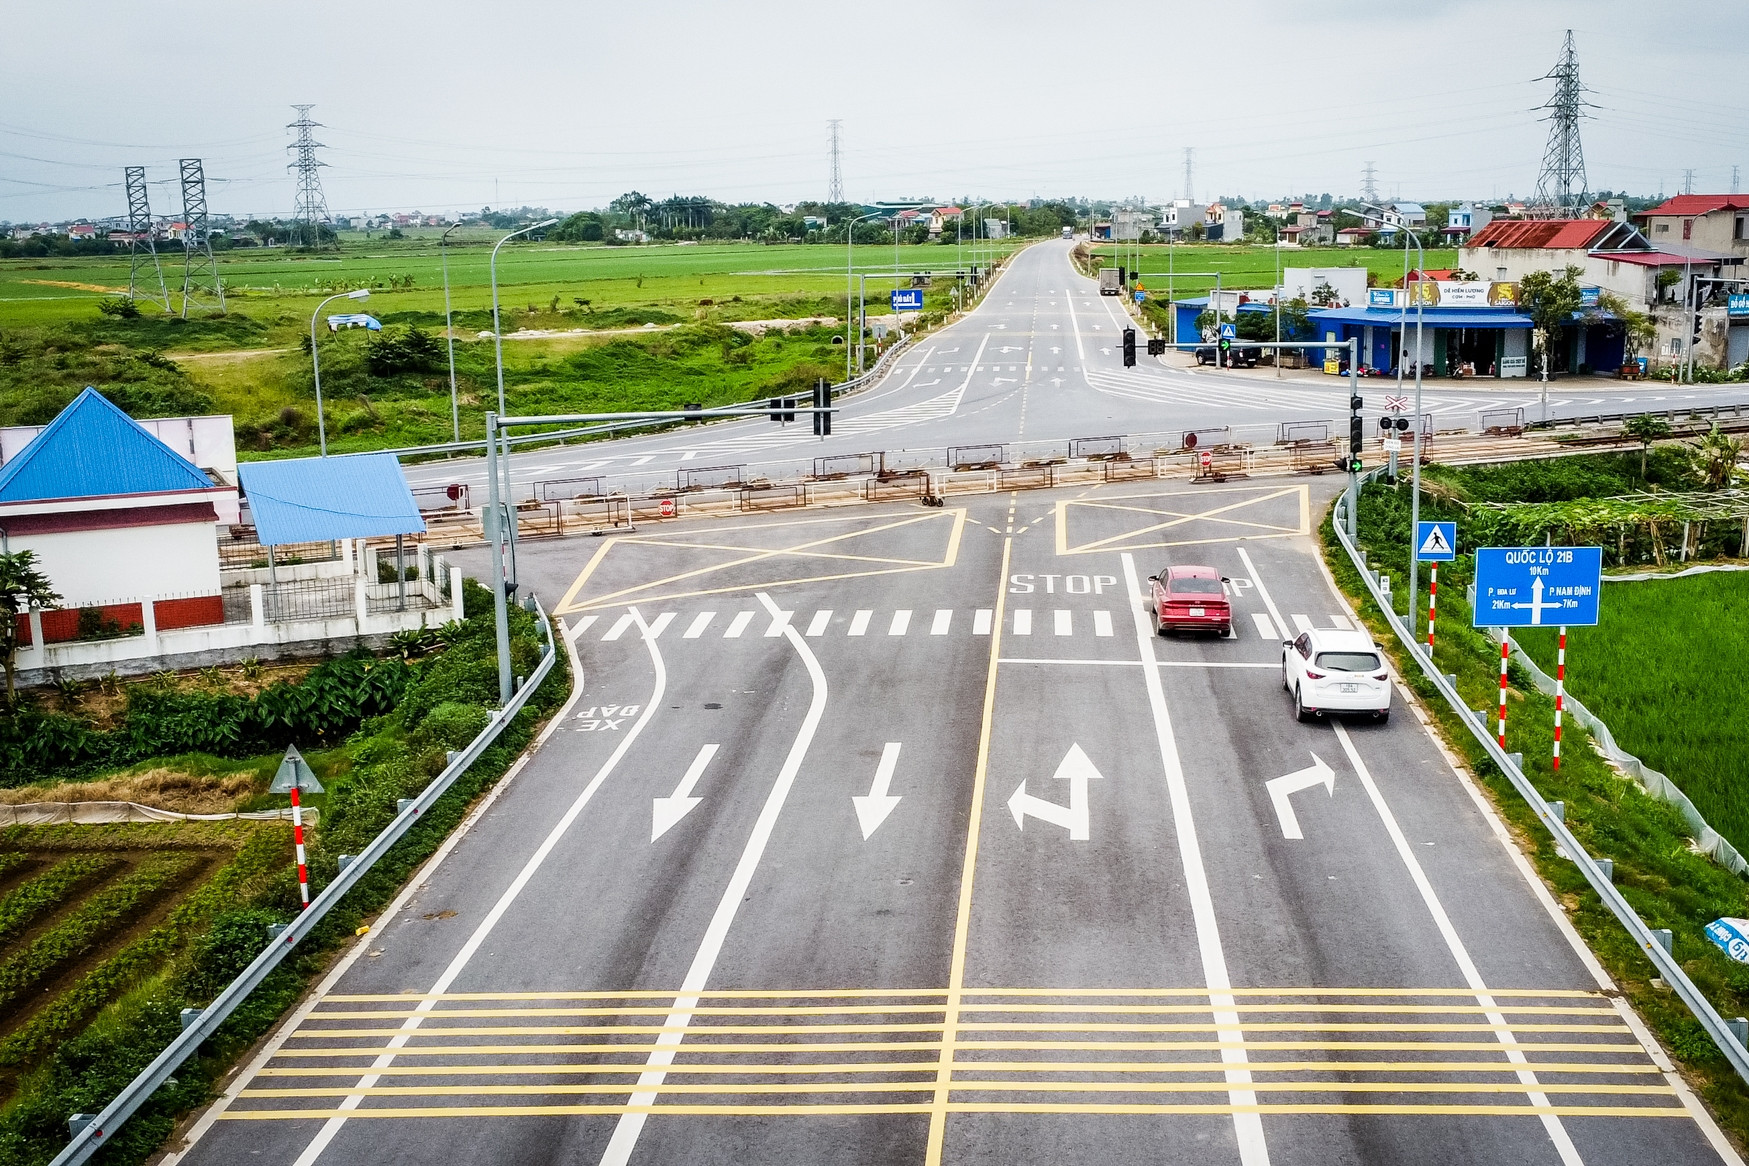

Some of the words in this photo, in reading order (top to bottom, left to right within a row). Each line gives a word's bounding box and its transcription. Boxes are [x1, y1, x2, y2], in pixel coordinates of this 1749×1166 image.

[660, 504, 674, 512] STOP
[1506, 549, 1536, 564] QUỐC
[1539, 548, 1554, 566] LỘ
[1556, 551, 1573, 563] 21B
[1529, 566, 1549, 576] 10Km
[1009, 574, 1117, 594] STOP
[1556, 586, 1573, 596] NAM
[1573, 585, 1592, 597] ĐỊNH
[1492, 600, 1511, 610] 21Km
[1562, 599, 1579, 608] 7Km
[576, 703, 641, 718] ĐẠP
[575, 718, 626, 731] XE
